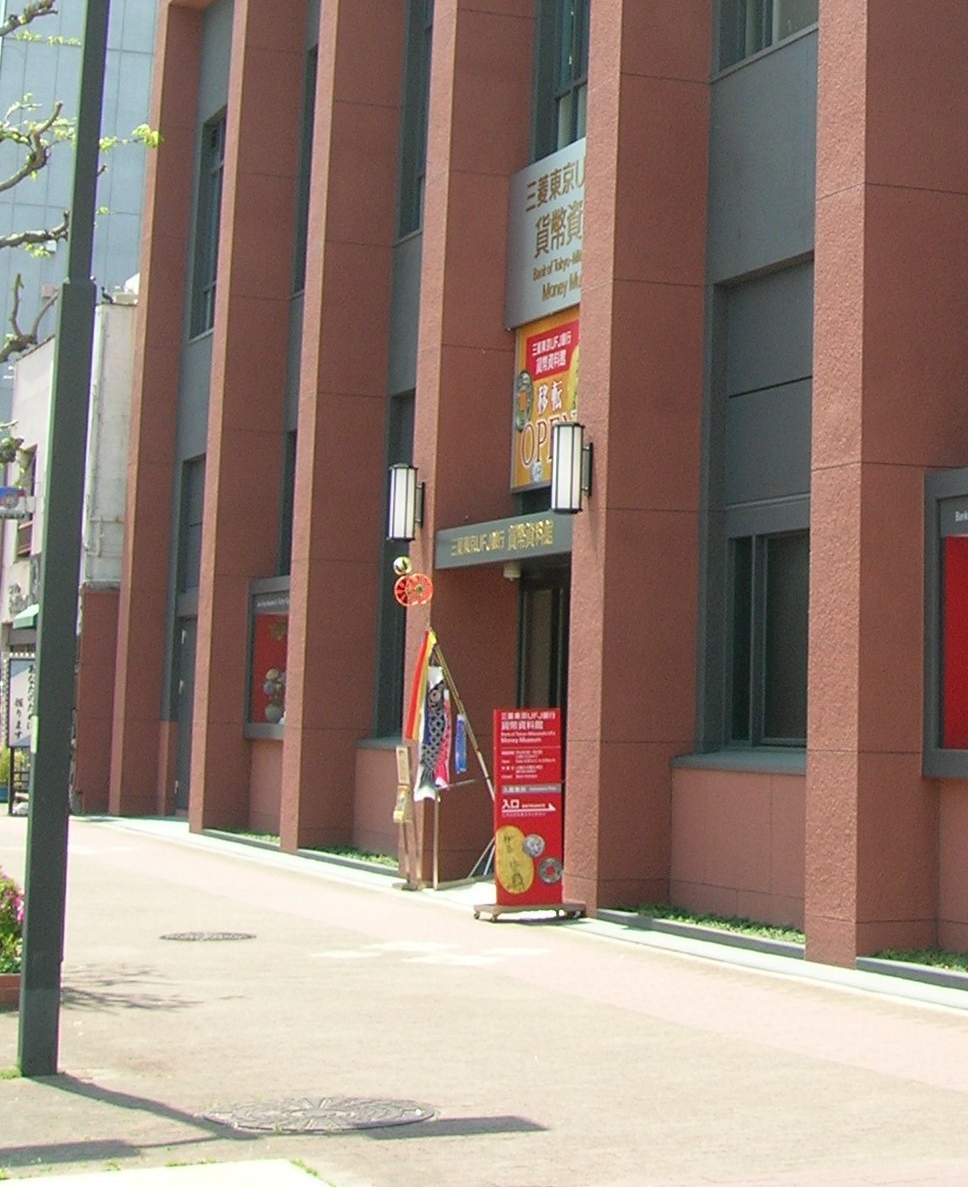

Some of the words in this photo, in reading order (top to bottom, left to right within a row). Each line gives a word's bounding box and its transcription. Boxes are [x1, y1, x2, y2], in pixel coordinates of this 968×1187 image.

[542, 282, 567, 301] Money
[520, 410, 578, 467] OP
[501, 799, 520, 809] 入口
